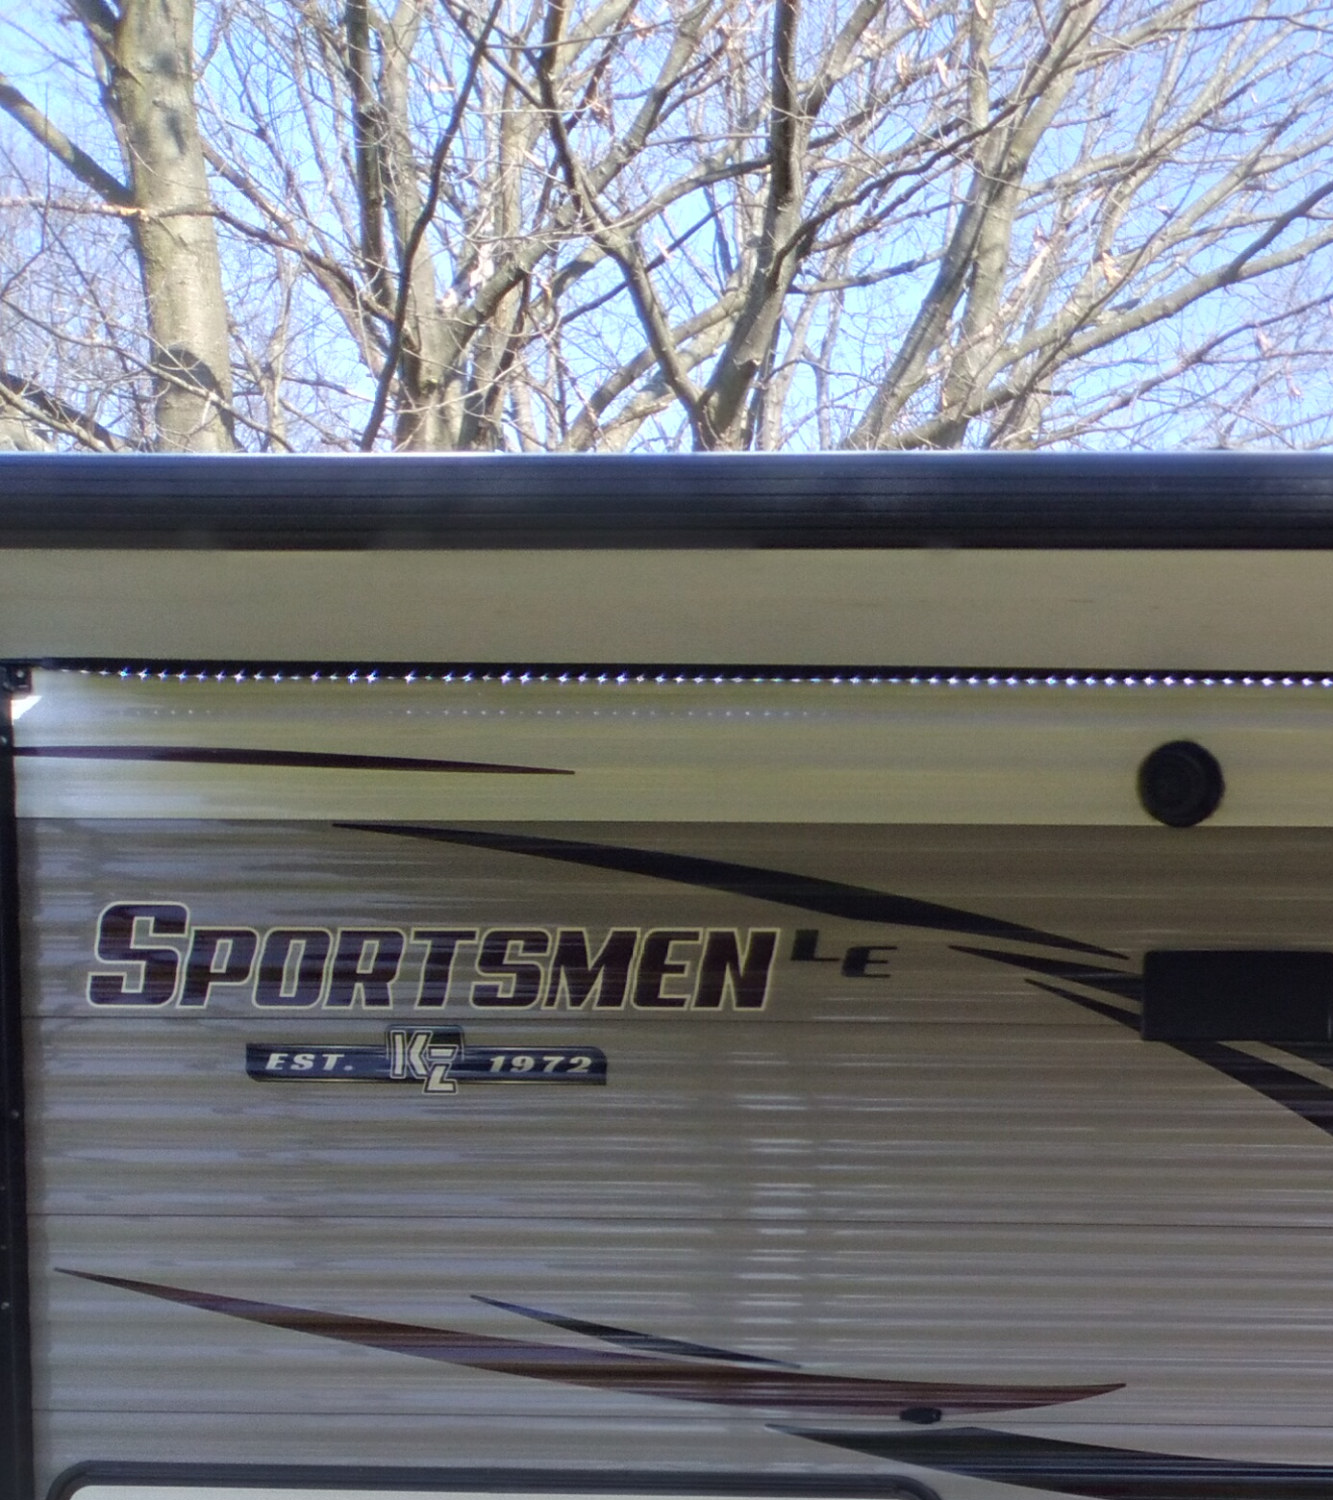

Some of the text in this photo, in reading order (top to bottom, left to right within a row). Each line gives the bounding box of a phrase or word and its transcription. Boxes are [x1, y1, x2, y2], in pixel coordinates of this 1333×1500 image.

[86, 901, 781, 1011] SPORTSMEN
[264, 1052, 355, 1072] EST.
[488, 1055, 593, 1074] 1972
